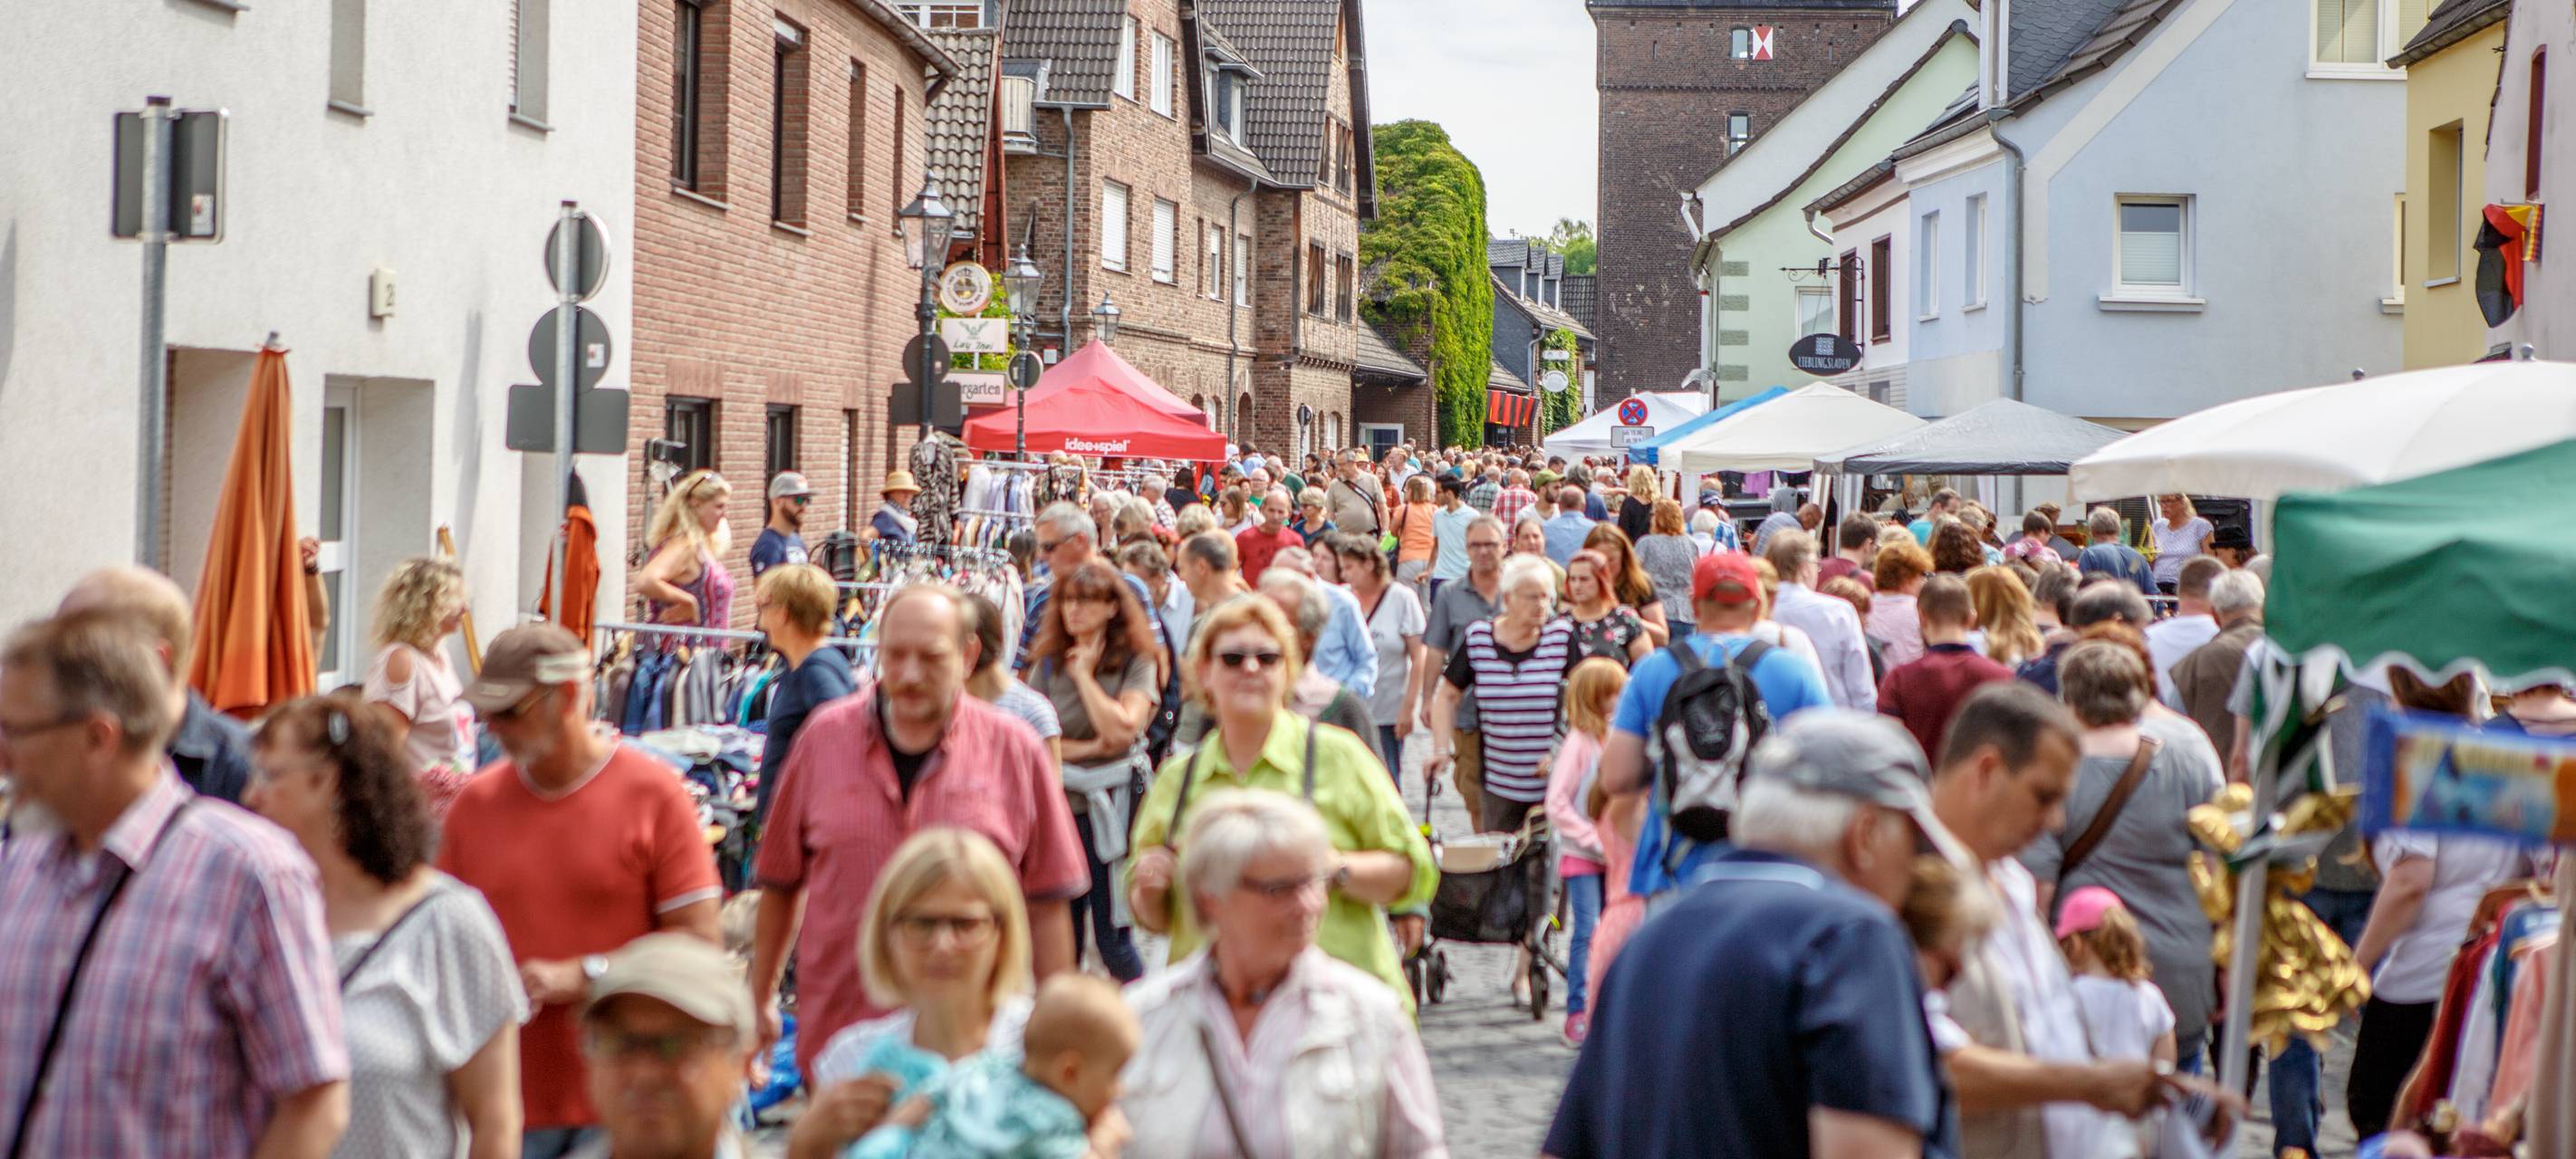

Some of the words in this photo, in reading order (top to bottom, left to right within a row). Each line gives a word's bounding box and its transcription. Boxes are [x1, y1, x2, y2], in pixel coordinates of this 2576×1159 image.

[1798, 356, 1851, 369] LIEBLINGSLADEN
[946, 379, 1001, 399] rgarten
[1064, 437, 1128, 455] idee+spiel
